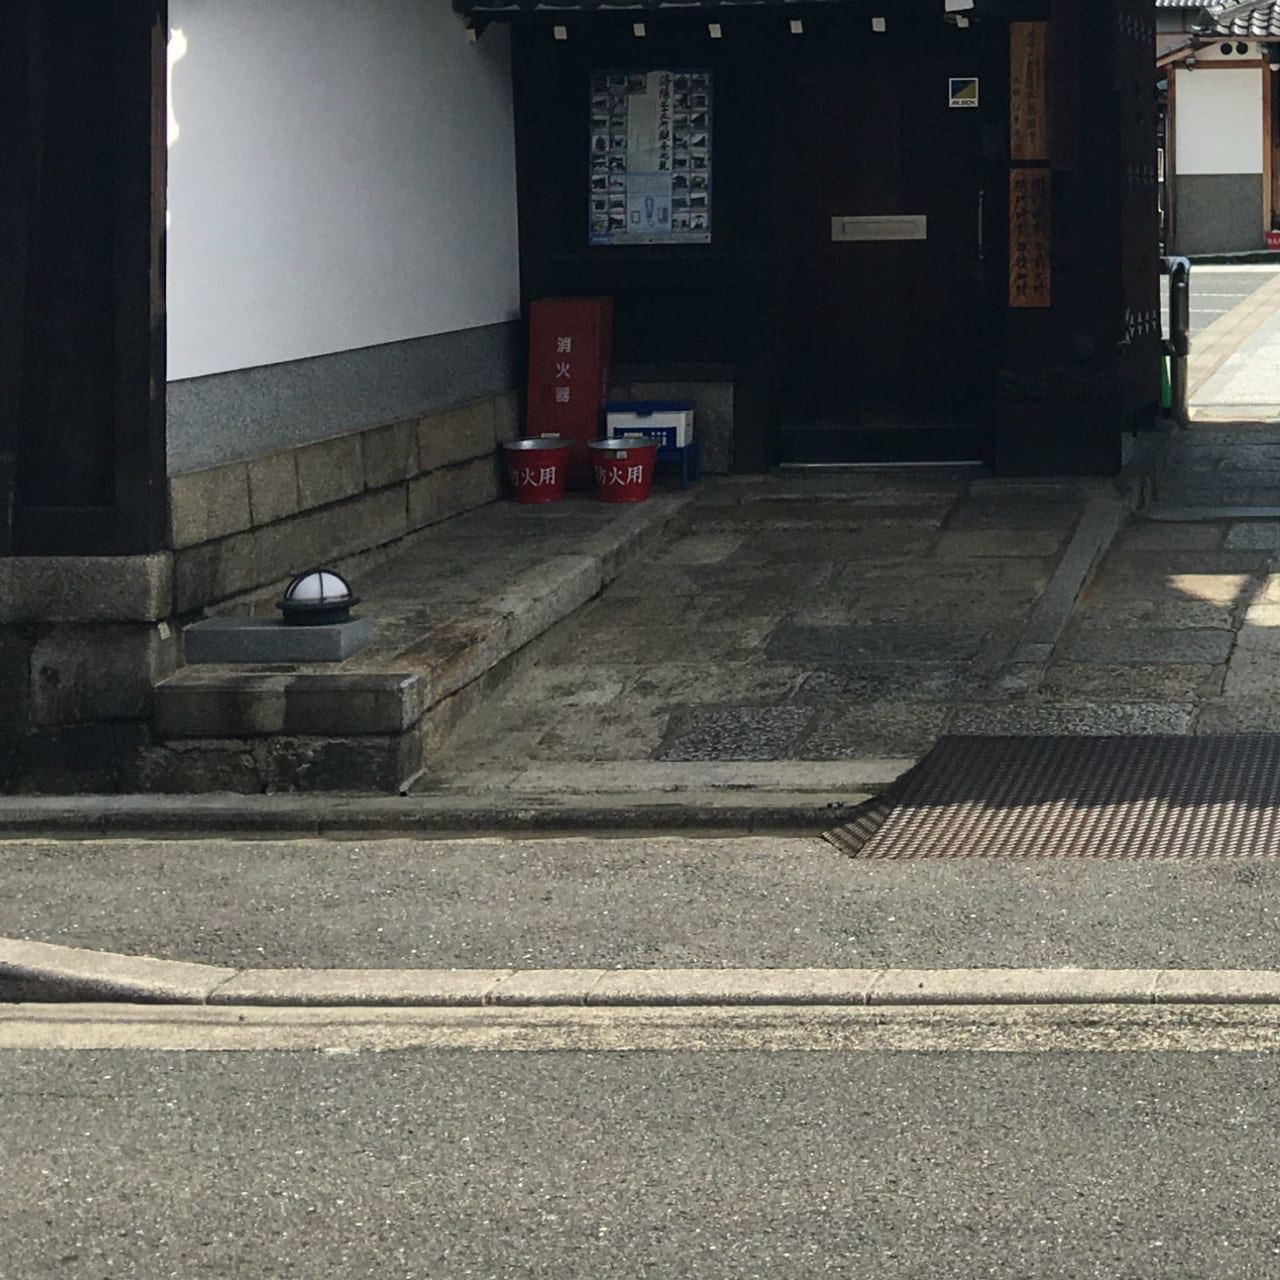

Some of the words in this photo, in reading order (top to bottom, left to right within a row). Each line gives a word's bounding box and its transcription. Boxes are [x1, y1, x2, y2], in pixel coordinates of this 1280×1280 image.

[555, 336, 572, 403] 消火器
[594, 465, 643, 487] 防火用
